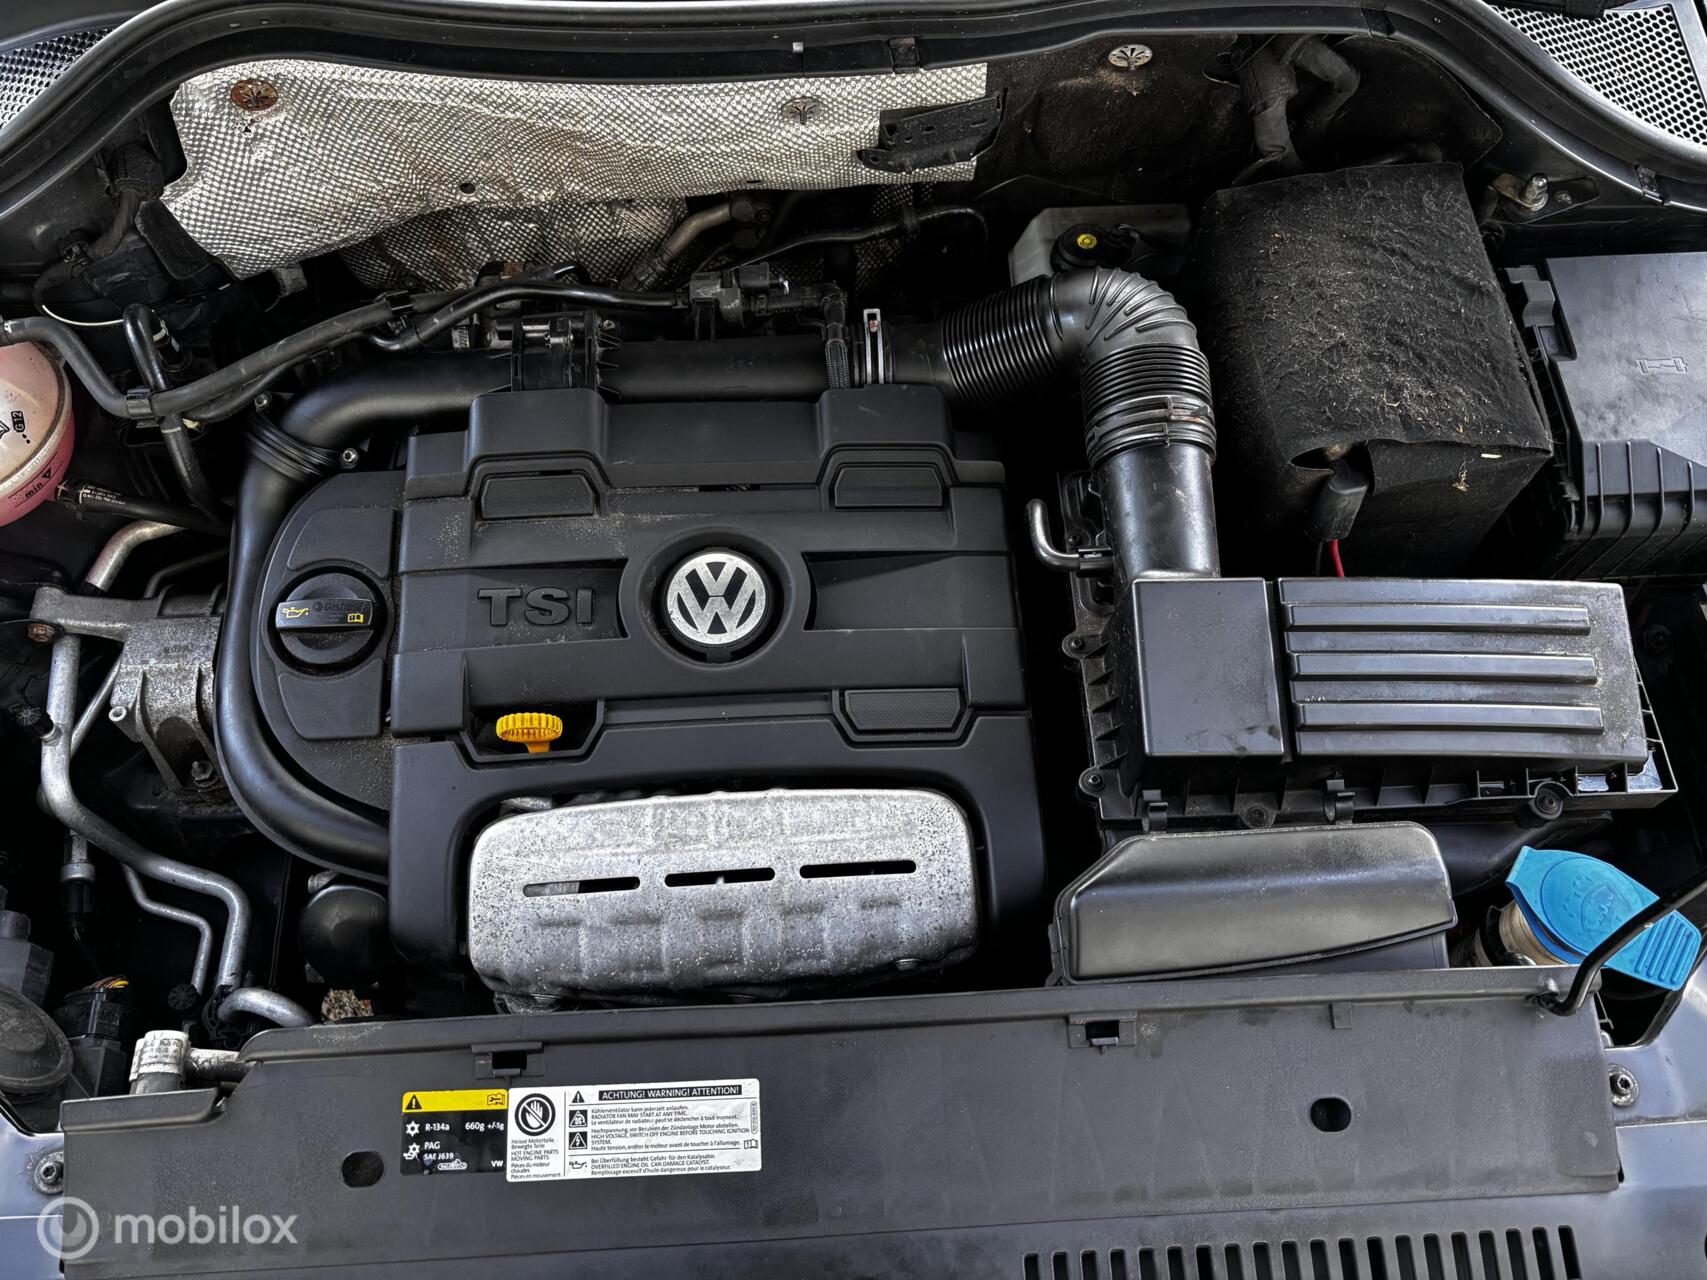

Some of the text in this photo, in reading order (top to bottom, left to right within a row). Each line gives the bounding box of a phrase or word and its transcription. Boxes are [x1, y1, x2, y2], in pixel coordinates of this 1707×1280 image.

[25, 482, 43, 498] min
[478, 587, 594, 626] TSI
[667, 553, 767, 645] VW
[602, 1086, 739, 1100] ACHTUNG! WARNING! ATTENTION!
[425, 1122, 504, 1132] R-134a 660g +/-5g
